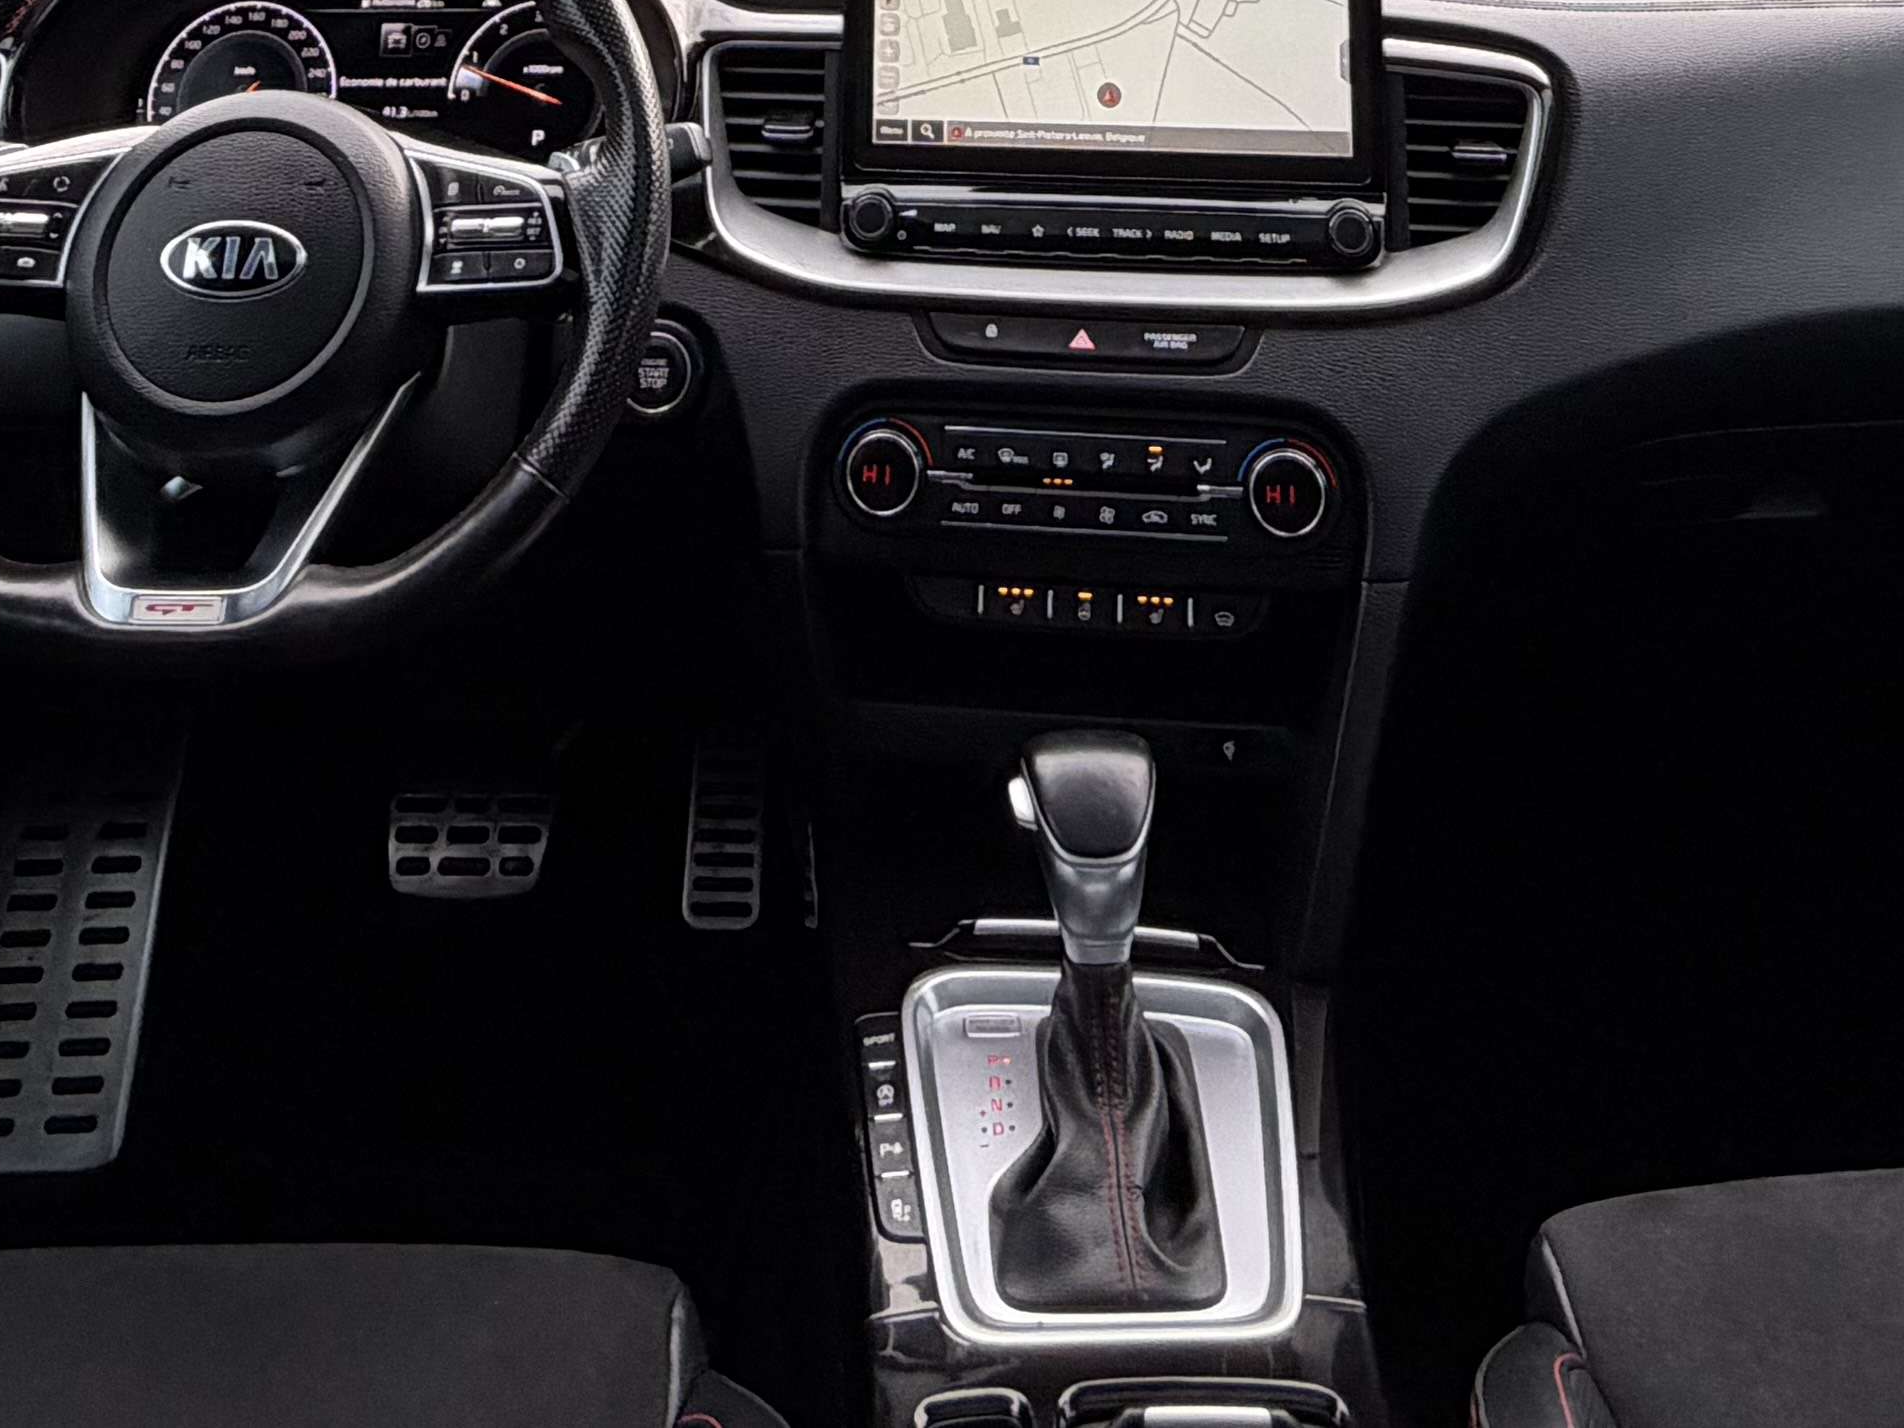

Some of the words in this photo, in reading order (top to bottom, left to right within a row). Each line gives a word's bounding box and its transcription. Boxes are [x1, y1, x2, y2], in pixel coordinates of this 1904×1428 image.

[531, 129, 545, 146] P
[934, 222, 956, 233] MAP
[981, 224, 1001, 234] NAV
[1075, 227, 1100, 237] SEEK
[1112, 228, 1143, 239] TRACK
[1164, 230, 1194, 240] RADIO
[1211, 231, 1242, 242] MEDIA
[1258, 233, 1291, 244] SETUP
[183, 236, 279, 280] KIA
[638, 367, 670, 378] START
[639, 378, 667, 389] STOP
[863, 464, 891, 485] HI
[1266, 484, 1295, 504] HI
[952, 502, 979, 514] AUTO
[1002, 503, 1022, 514] OFF
[991, 1098, 1003, 1112] N
[992, 1122, 1005, 1136] D
